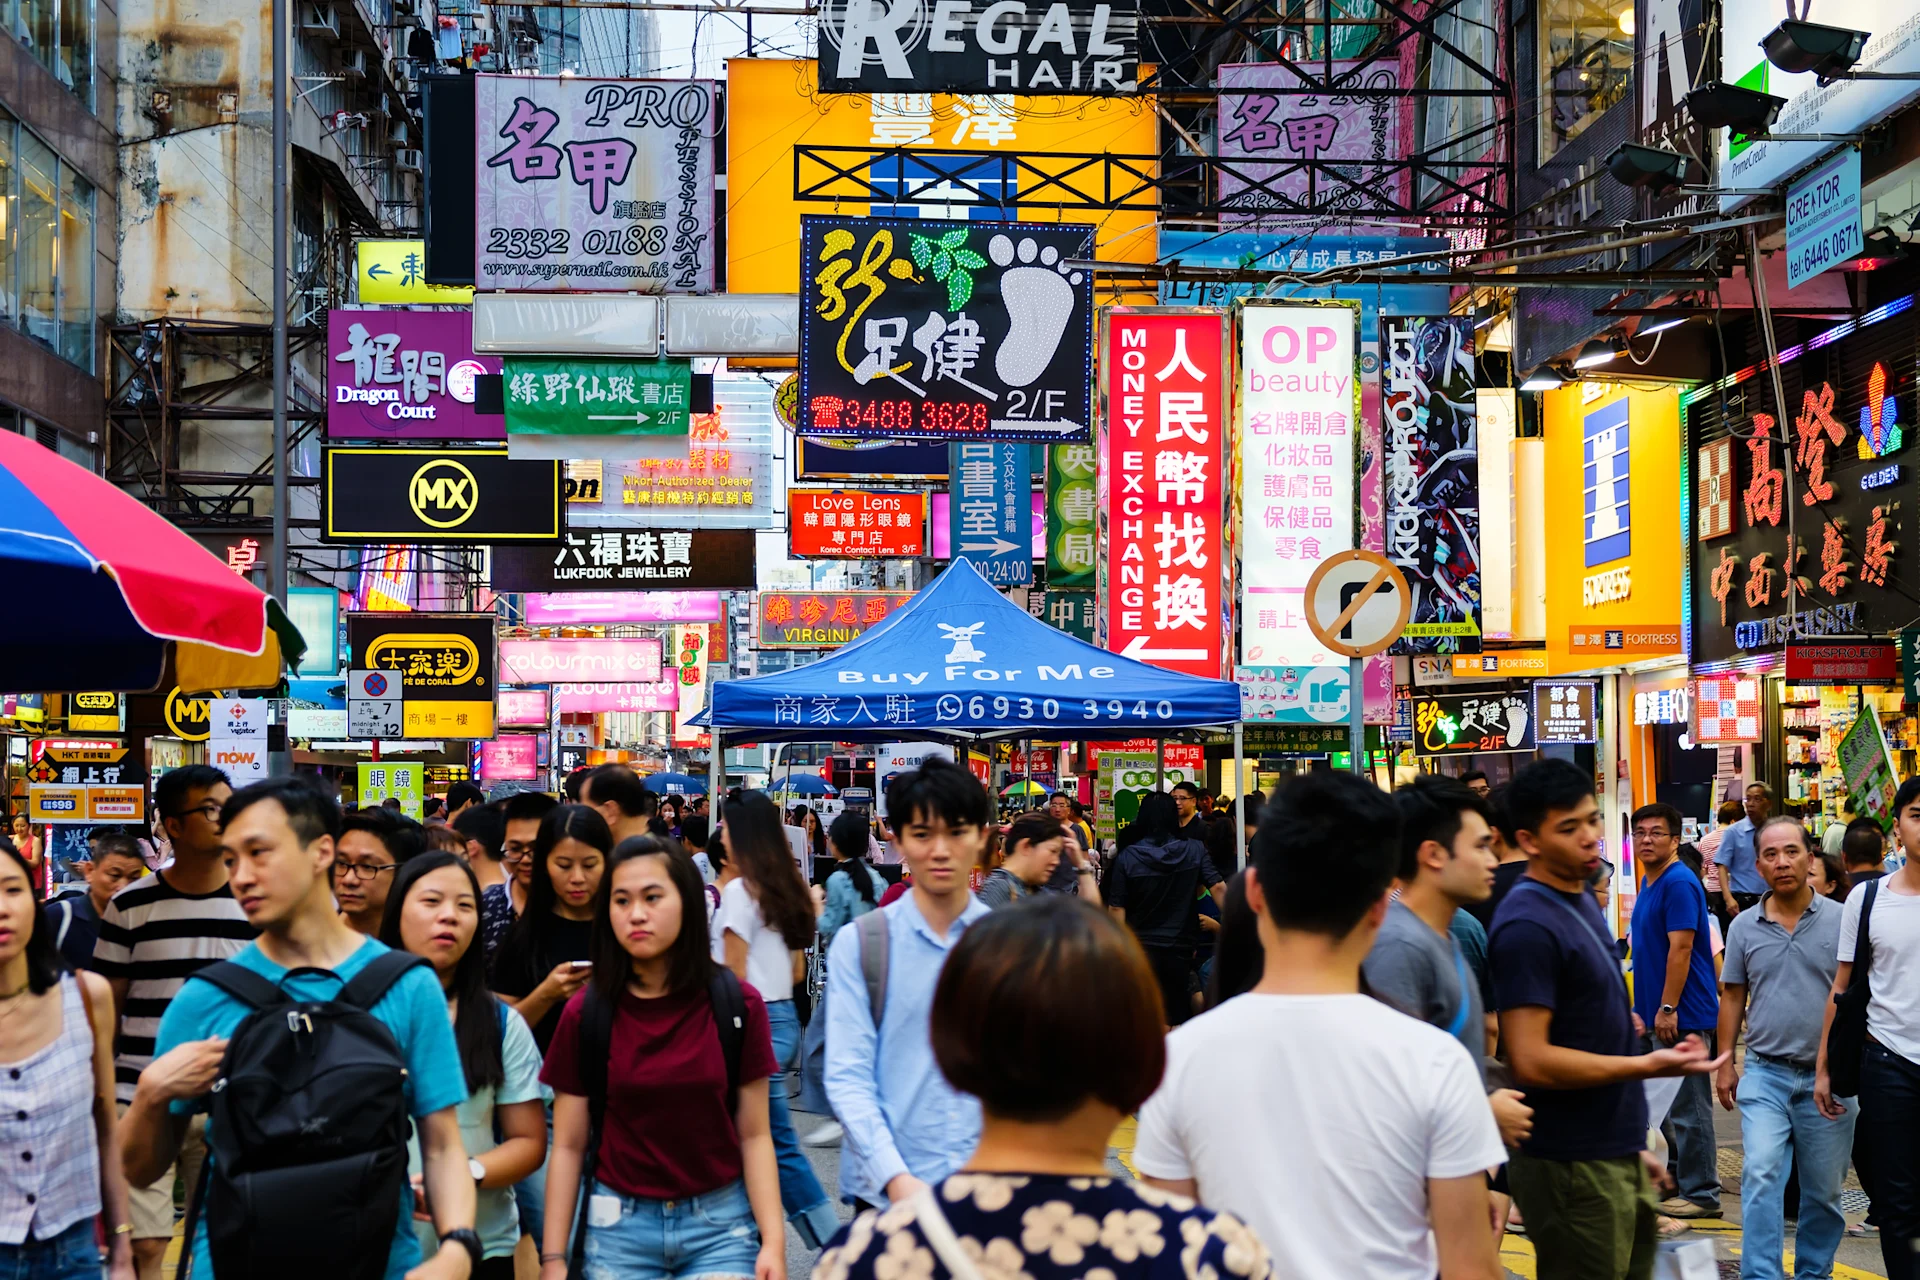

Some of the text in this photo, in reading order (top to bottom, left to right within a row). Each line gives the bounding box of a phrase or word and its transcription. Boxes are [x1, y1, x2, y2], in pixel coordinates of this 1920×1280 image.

[836, 0, 1126, 80] REGAL
[987, 58, 1136, 92] HAIR
[585, 84, 710, 129] PRO
[869, 93, 1017, 146] 豐澤
[486, 96, 638, 215] 名甲
[1731, 143, 1767, 180] PrimeCredit
[612, 200, 667, 220] 旗艦店
[486, 225, 668, 260] 2332 0188
[1833, 221, 1859, 258] 0671
[483, 261, 669, 280] www.supernail.com.hk
[1261, 325, 1338, 365] OP
[1249, 369, 1349, 398] beauty
[336, 385, 401, 406] Dragon
[1005, 389, 1067, 419] 2/F
[387, 401, 437, 420] Court
[657, 412, 682, 425] 2/F
[845, 399, 988, 431] 3488 3628
[1249, 410, 1347, 437] 名牌開倉
[1389, 323, 1421, 566] KICKSPROJECT
[623, 475, 754, 487] Nikon Authorized Dealer
[1120, 328, 1147, 631] MONEY EXCHANGE
[1151, 327, 1210, 632] 人民幣找換
[1263, 474, 1333, 499] 護膚品
[1860, 463, 1900, 491] GOLDEN
[417, 478, 470, 510] MX
[812, 495, 901, 512] Love Lens
[803, 512, 913, 528] 韓國隱形眼鏡
[1263, 504, 1333, 530] 保健品
[831, 529, 884, 546] 專門店
[1274, 535, 1322, 561] 零食
[553, 532, 693, 567] 六福珠寶
[820, 546, 896, 555] Korea Contact Lens
[901, 544, 918, 555] 3/F
[553, 566, 693, 579] LUKFOOK JEWELLERY
[1583, 566, 1631, 607] FORTRESS
[1573, 632, 1678, 646] 豐澤 FORTRESS
[1455, 657, 1545, 669] 豐澤 FORTRESS
[1796, 647, 1885, 659] KICKSPROJECT
[416, 678, 426, 686] DE
[426, 678, 452, 686] CORAL
[837, 664, 1115, 686] Buy For Me
[175, 699, 211, 723] MX
[358, 707, 374, 715] 上午
[382, 702, 392, 716] 7
[772, 693, 917, 726] 商家入駐
[967, 695, 1174, 721] 6930 3940
[1669, 687, 1689, 724] FO
[384, 723, 400, 736] 12
[408, 713, 469, 726] 商場一樓
[1479, 735, 1506, 750] 2/F
[62, 751, 80, 759] HKT
[216, 751, 256, 764] now
[891, 757, 906, 766] 4G
[61, 766, 121, 784] 網上行
[369, 769, 411, 788] 眼鏡
[1125, 772, 1182, 784] 華英局
[51, 800, 73, 810] $98
